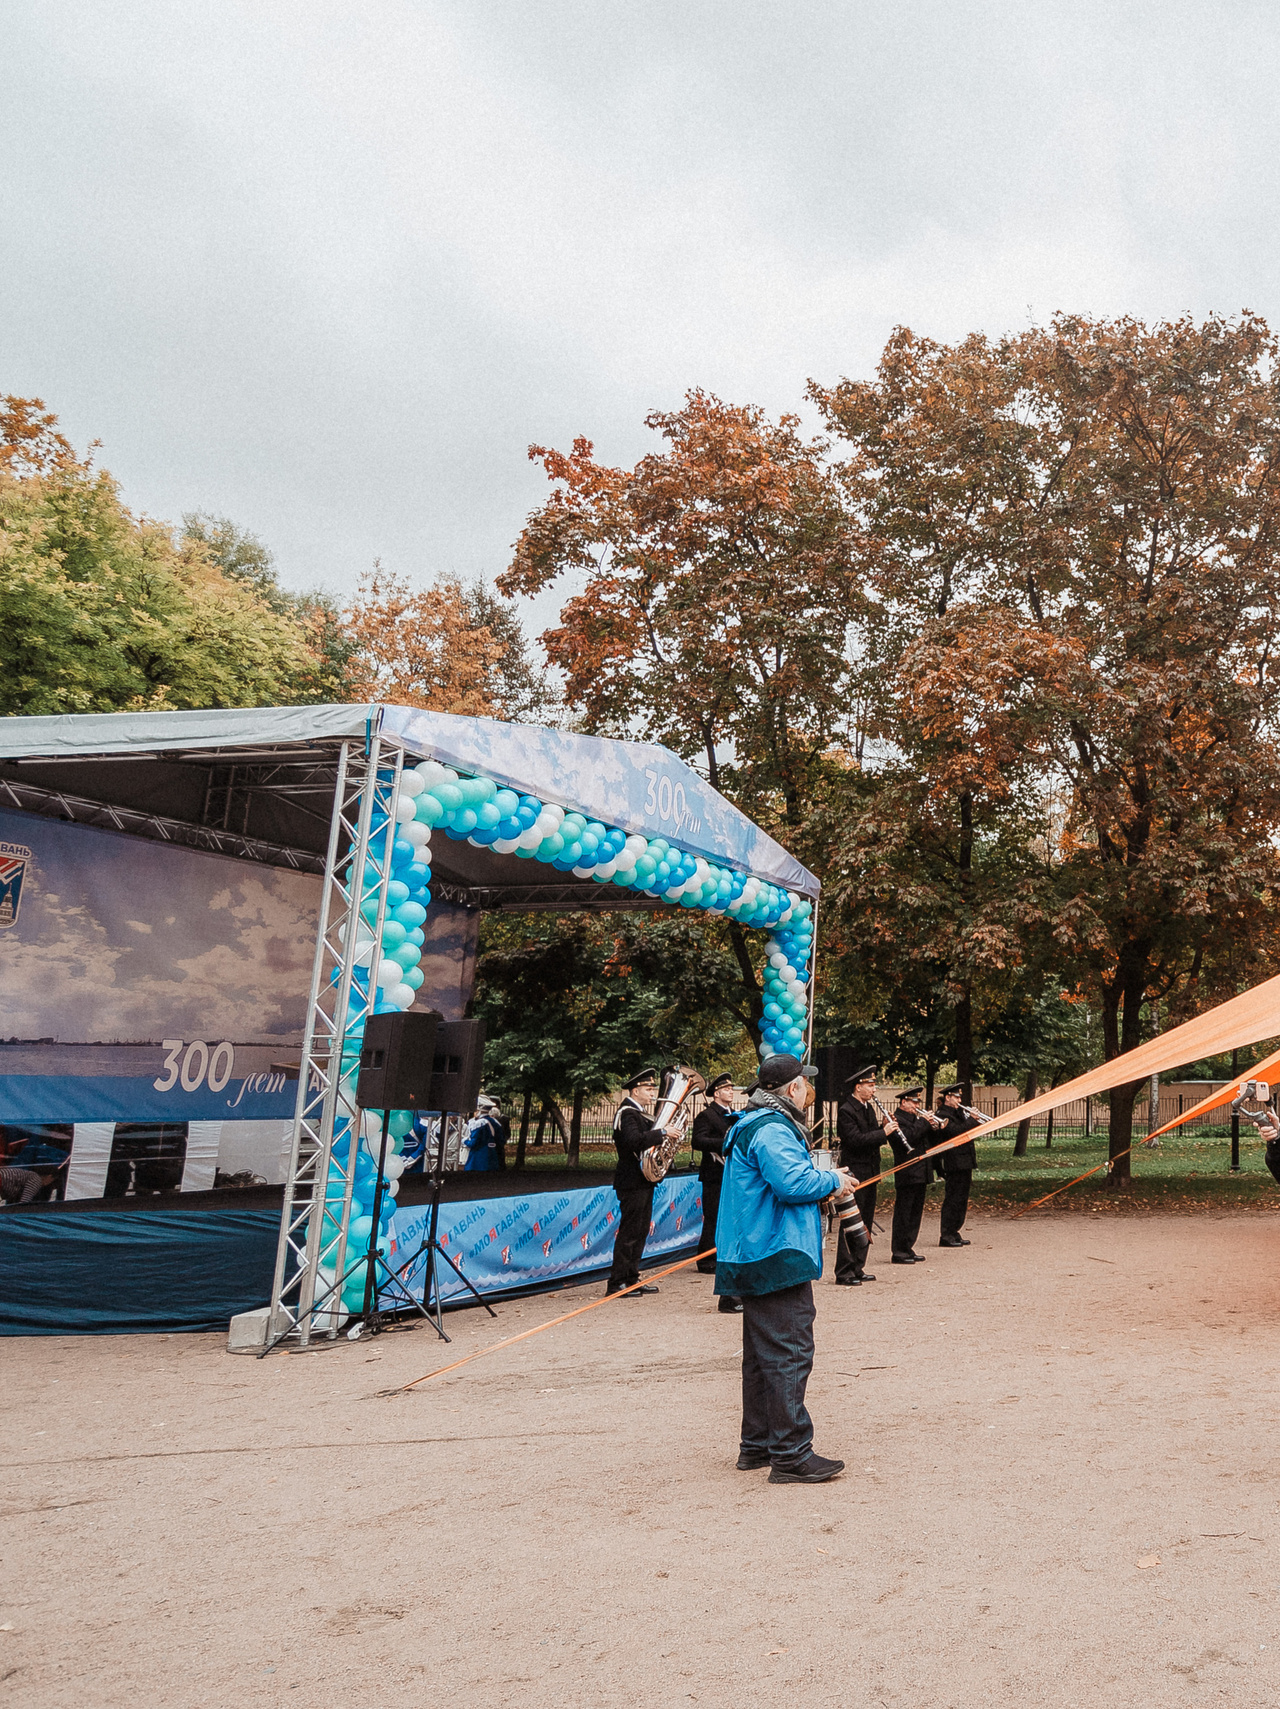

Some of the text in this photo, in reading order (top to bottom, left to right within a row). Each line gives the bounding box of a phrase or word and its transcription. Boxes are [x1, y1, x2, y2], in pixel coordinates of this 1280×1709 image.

[644, 768, 686, 825] 300
[153, 1039, 235, 1092] 300
[226, 1072, 287, 1108] лет
[440, 1206, 486, 1249] ЯГАВАНЬ
[469, 1202, 530, 1258] #МОЯГАВАНЬ
[514, 1197, 570, 1252] #МОЯГАВАНЬ
[556, 1192, 605, 1245] #МОЯГАВАНЬ
